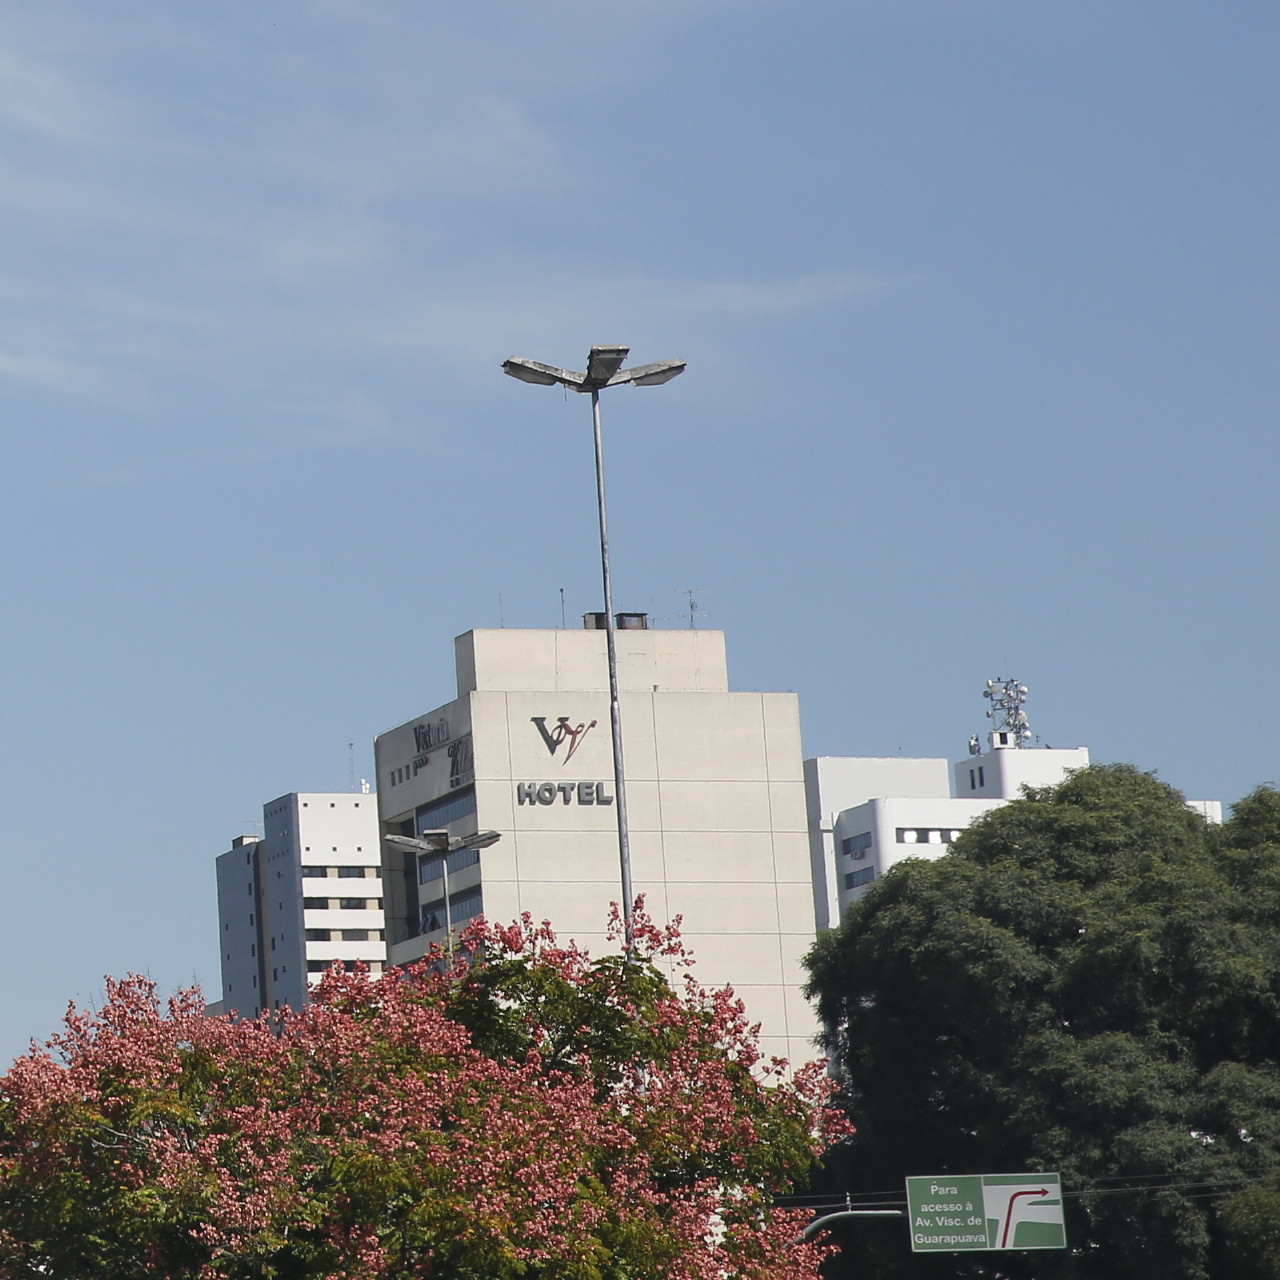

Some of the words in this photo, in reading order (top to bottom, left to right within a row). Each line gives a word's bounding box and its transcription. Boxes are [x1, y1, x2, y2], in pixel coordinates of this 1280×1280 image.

[517, 782, 614, 806] HOTEL
[930, 1185, 958, 1195] Para
[921, 1203, 963, 1212] acesso
[915, 1217, 933, 1227] Av.
[935, 1216, 964, 1226] Visc.
[967, 1215, 982, 1226] de
[914, 1233, 986, 1245] Guarapuava
